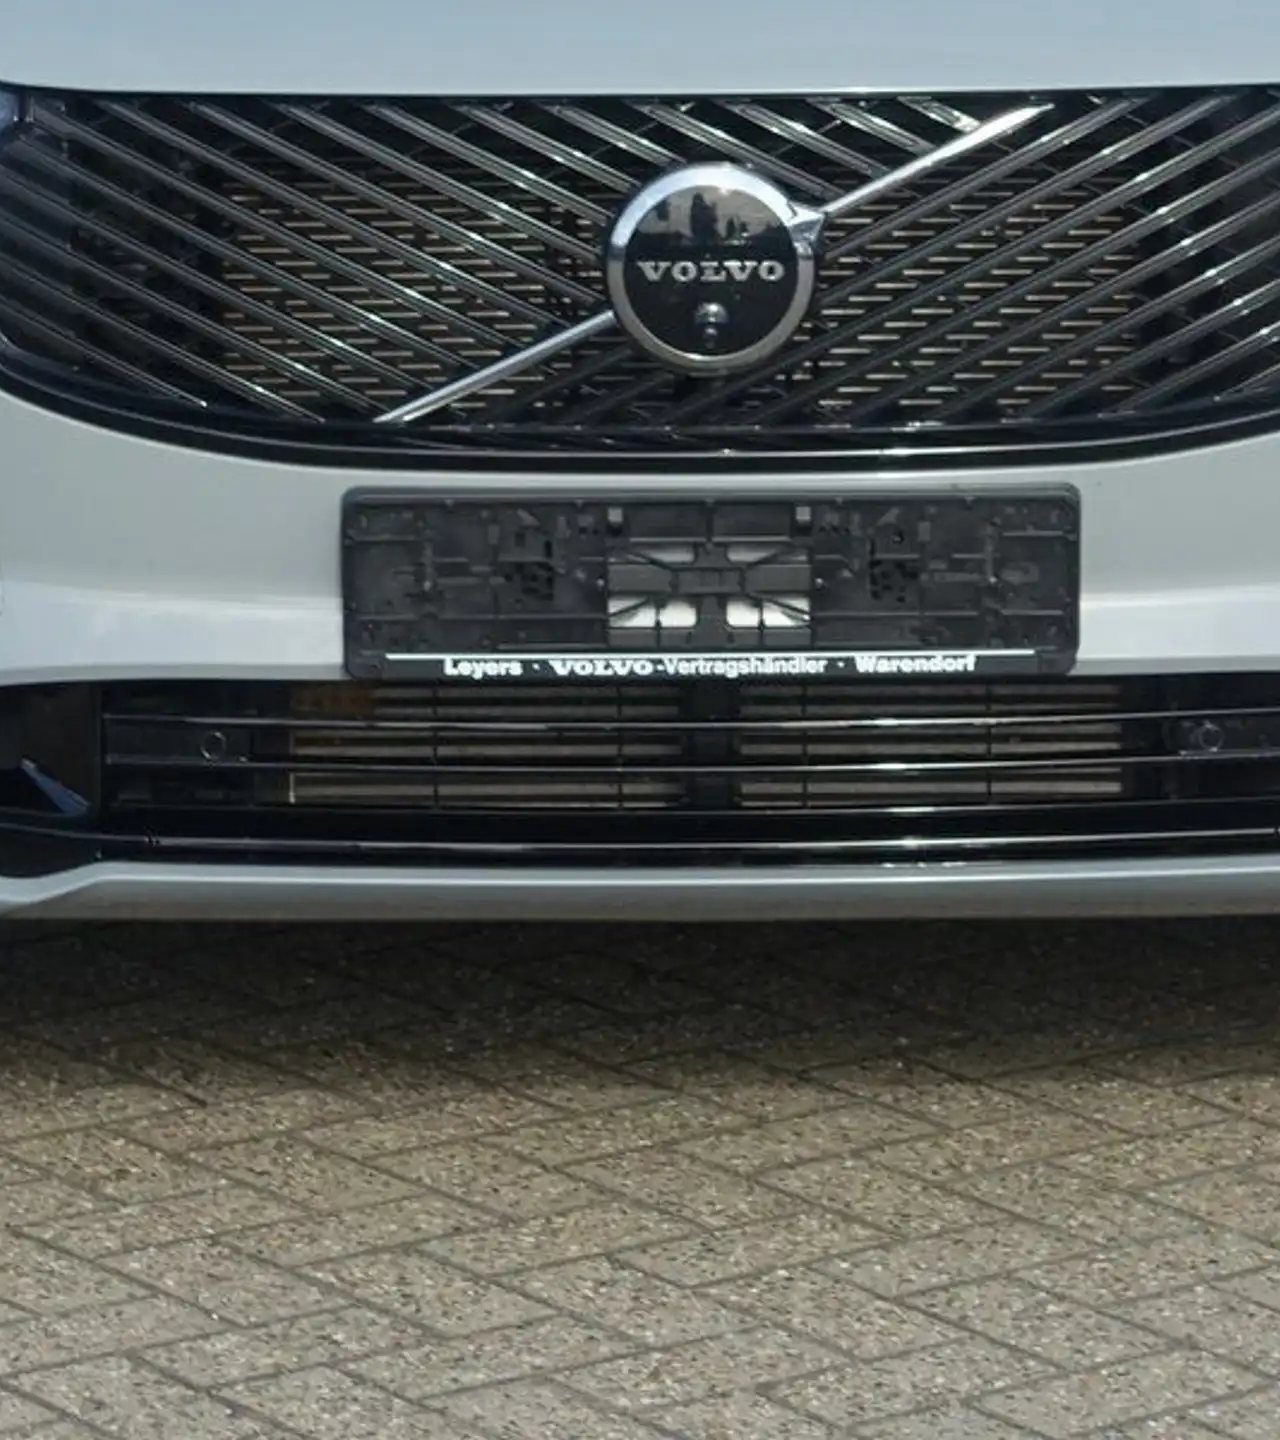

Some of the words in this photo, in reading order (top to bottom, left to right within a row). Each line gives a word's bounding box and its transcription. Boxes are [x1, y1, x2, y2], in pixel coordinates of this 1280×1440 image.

[636, 260, 785, 282] VOLVO
[444, 657, 523, 679] Leyers
[855, 654, 976, 674] Warendorf
